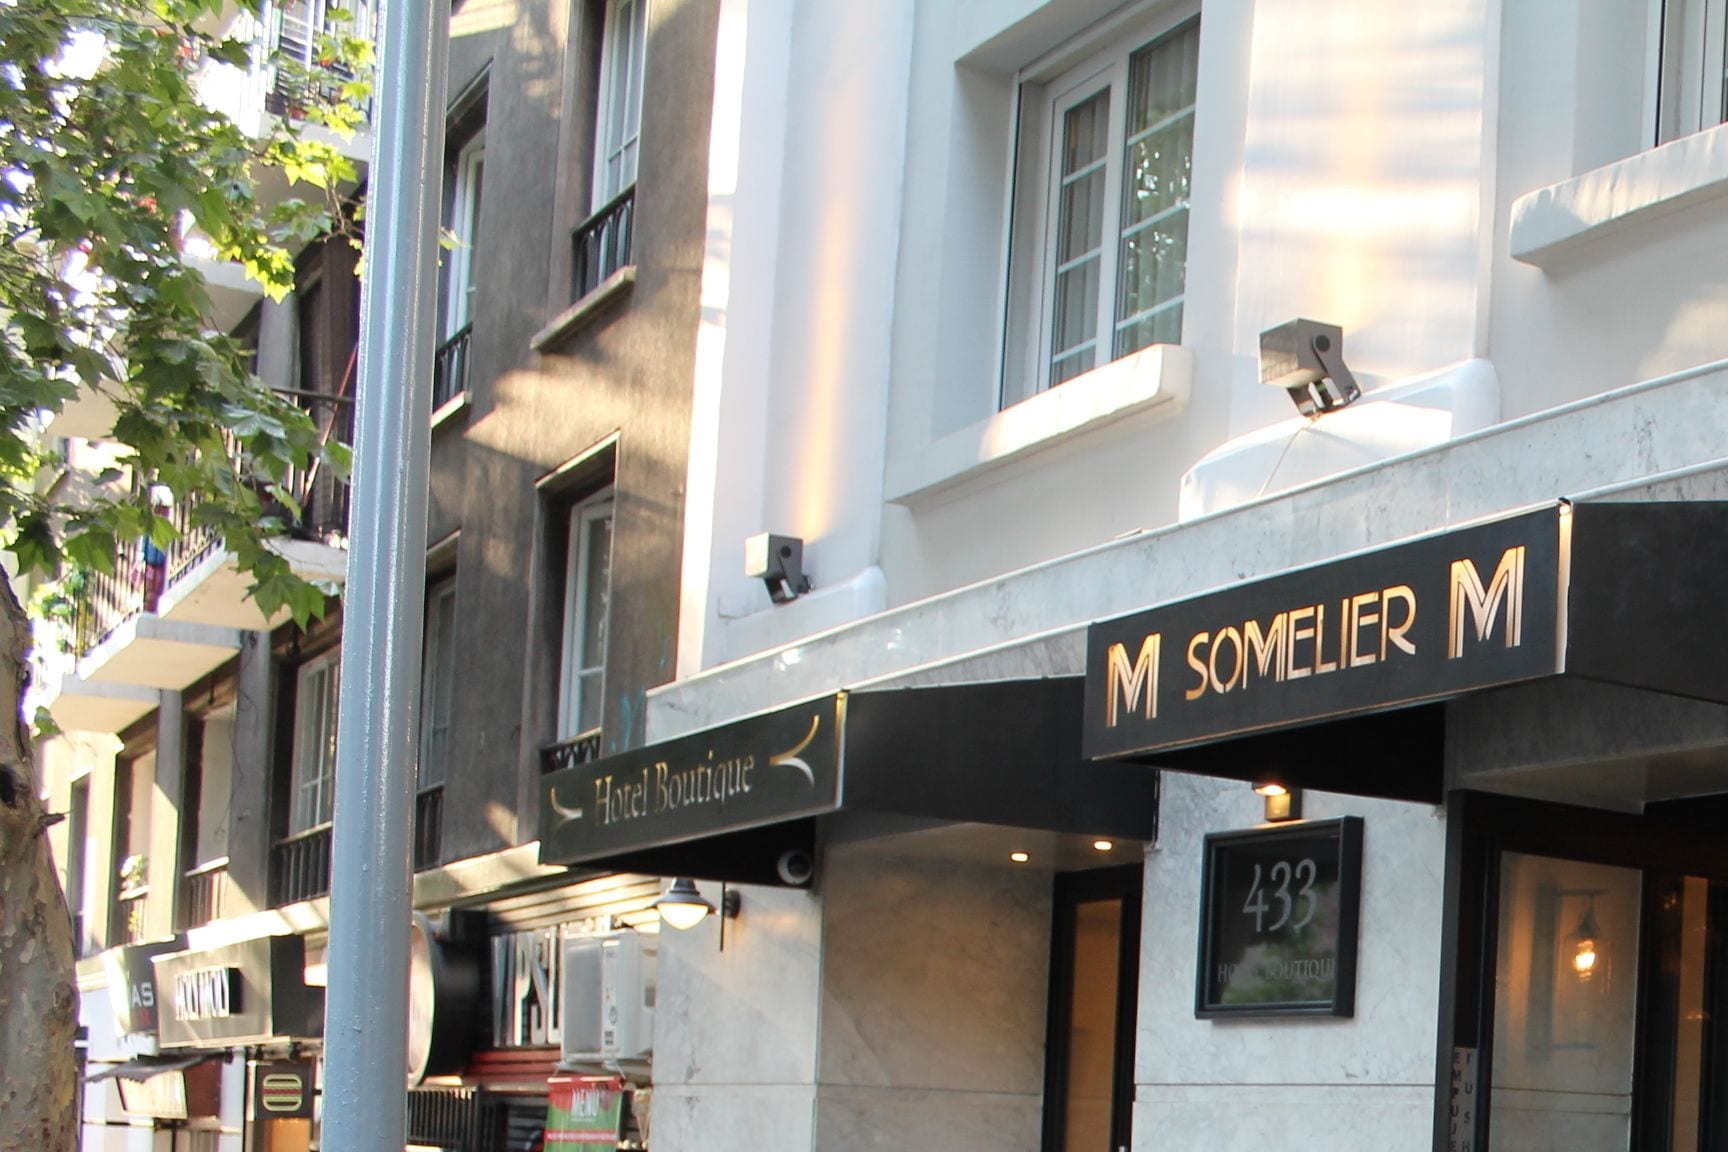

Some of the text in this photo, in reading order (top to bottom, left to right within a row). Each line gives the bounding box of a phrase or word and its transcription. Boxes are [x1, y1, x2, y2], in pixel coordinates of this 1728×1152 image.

[1105, 545, 1527, 728] M SOMELIER M
[594, 750, 755, 827] Hotel Boutique
[1242, 858, 1318, 933] 433
